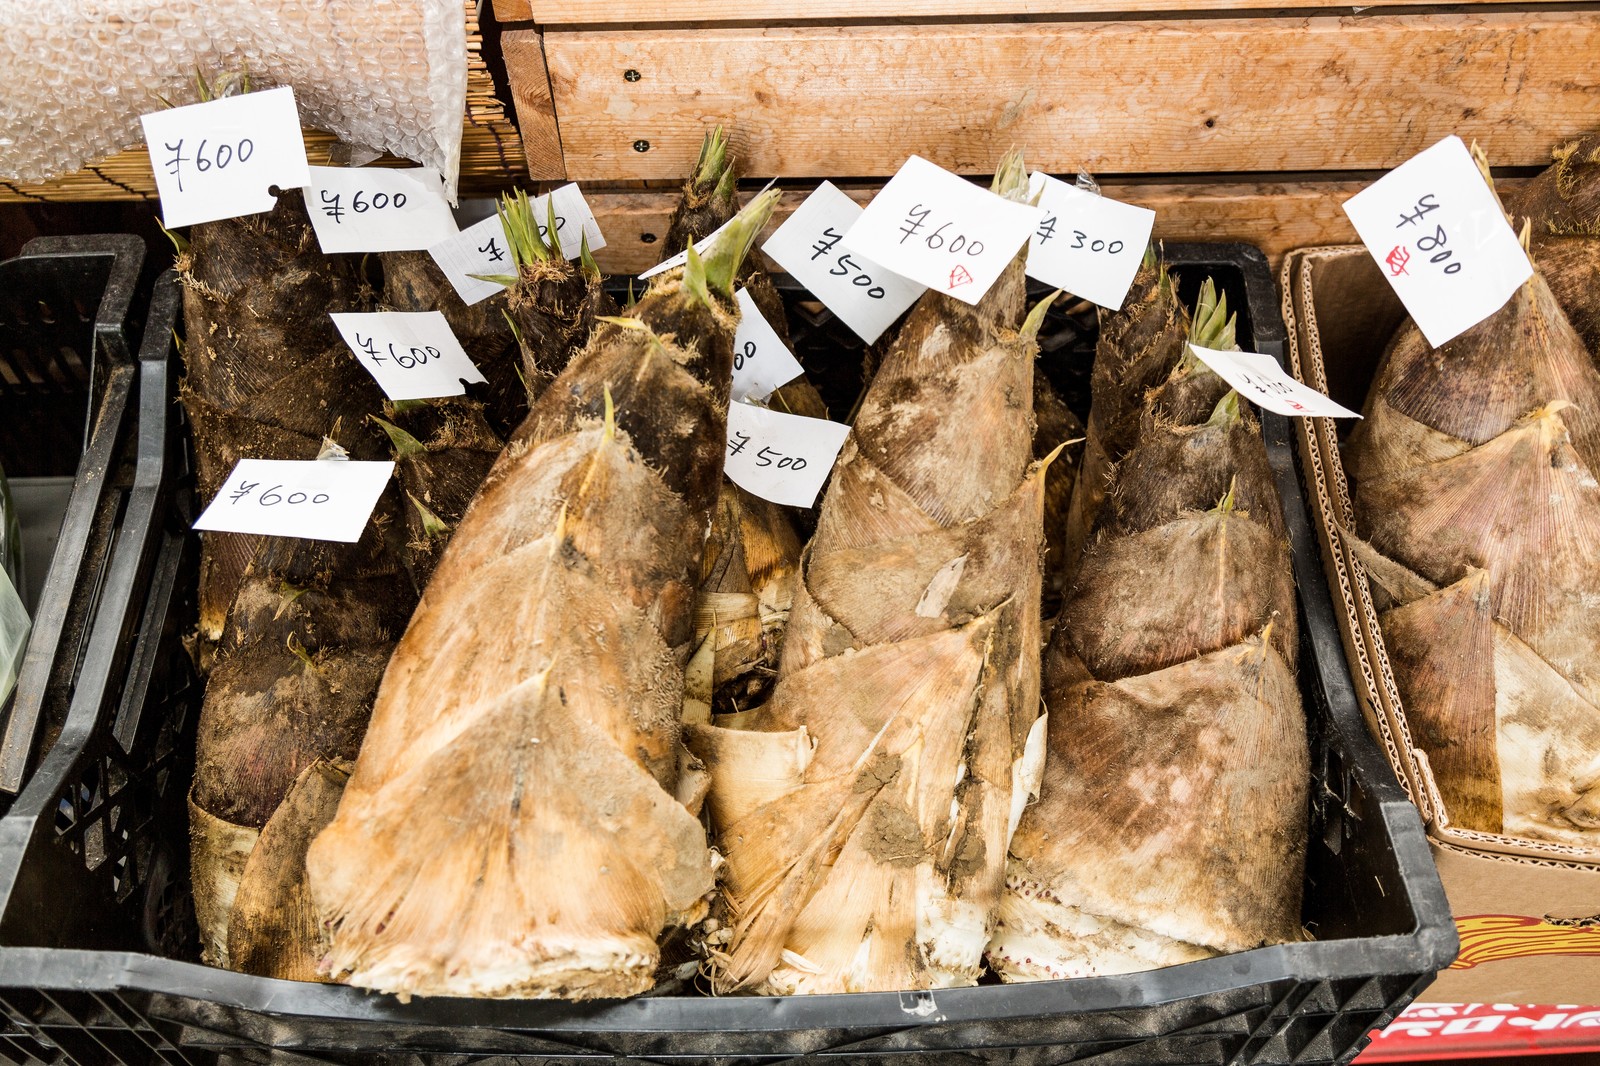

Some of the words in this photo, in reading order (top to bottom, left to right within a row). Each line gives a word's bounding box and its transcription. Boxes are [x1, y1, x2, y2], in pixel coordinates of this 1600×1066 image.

[164, 138, 254, 193] ¥600
[320, 189, 407, 225] ¥600
[478, 216, 566, 261] ¥00
[899, 204, 985, 257] ¥600
[1036, 210, 1124, 255] ¥300
[1396, 193, 1462, 274] ¥800
[810, 227, 885, 299] ¥500
[355, 332, 441, 369] ¥600
[731, 341, 757, 374] 00
[727, 431, 807, 471] ¥500
[230, 480, 330, 506] ¥600
